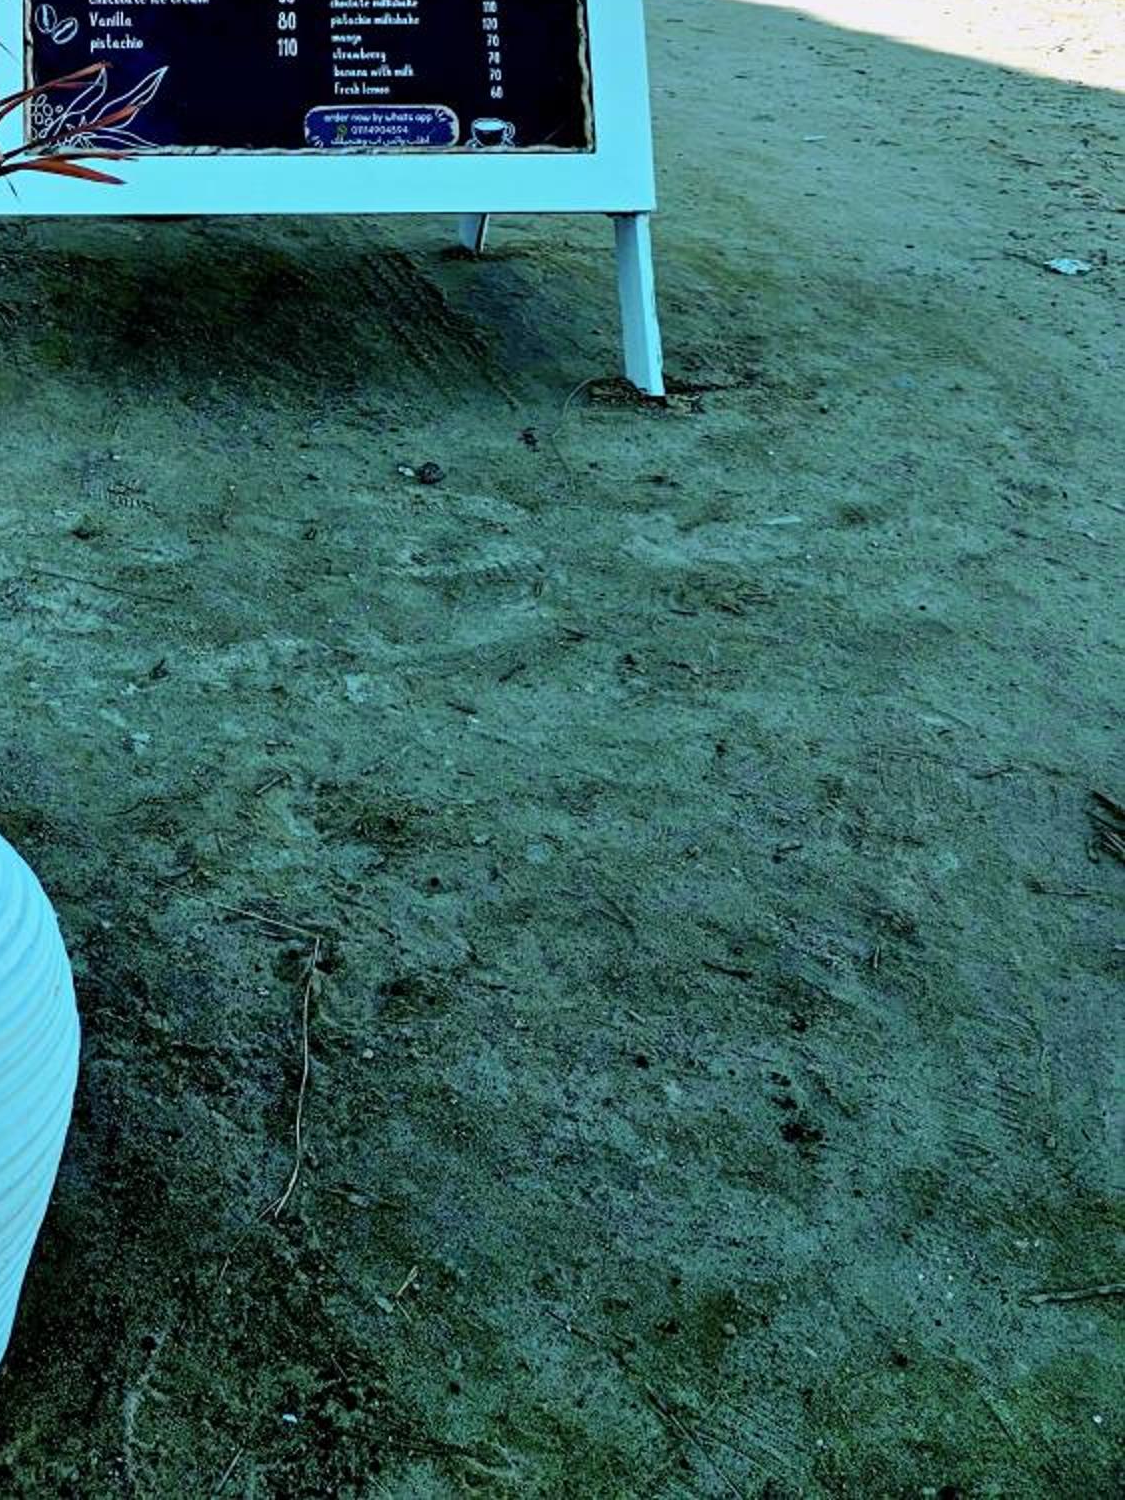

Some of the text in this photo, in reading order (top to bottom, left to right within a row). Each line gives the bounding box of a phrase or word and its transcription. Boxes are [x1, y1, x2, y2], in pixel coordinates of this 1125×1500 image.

[89, 11, 132, 26] Vanilla
[278, 12, 296, 29] 80
[91, 34, 143, 53] pistachio
[278, 38, 297, 56] 110
[372, 113, 383, 123] by
